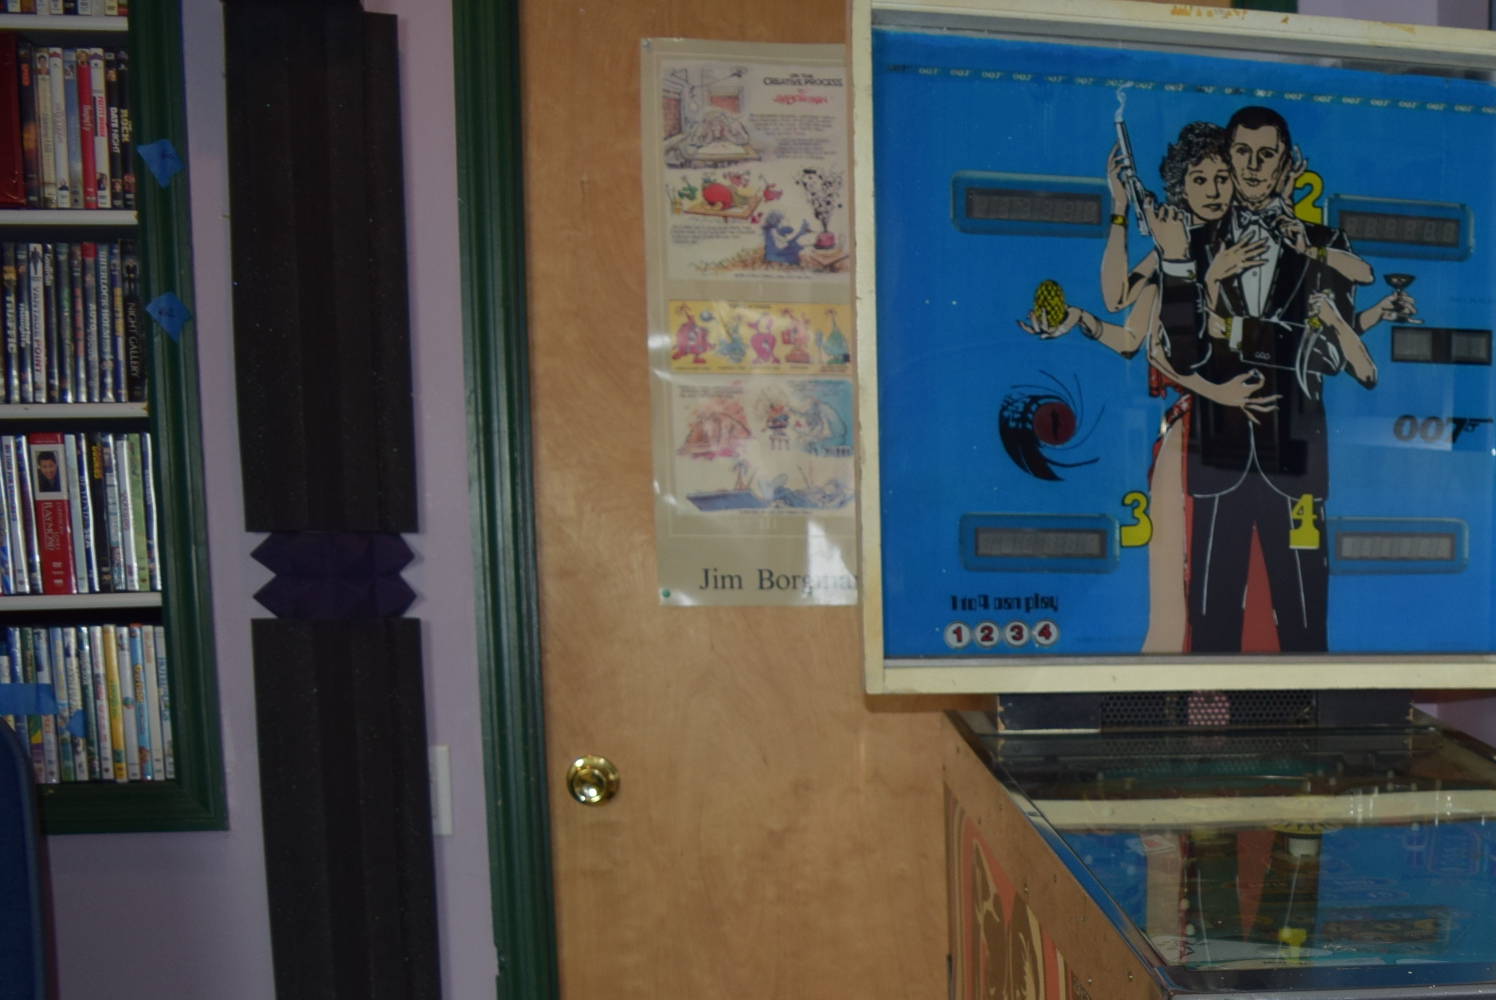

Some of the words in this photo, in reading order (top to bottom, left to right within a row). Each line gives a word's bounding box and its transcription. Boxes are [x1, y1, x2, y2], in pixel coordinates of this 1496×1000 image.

[110, 106, 119, 128] DATE
[112, 129, 120, 154] NIGHT
[1293, 170, 1324, 226] 2
[98, 251, 109, 306] SHERLOCK
[5, 294, 18, 354] TRAFFIC
[33, 286, 43, 338] VANTAGE
[88, 303, 97, 331] AUTO
[127, 302, 138, 334] NIGHT
[34, 339, 43, 374] POINT
[128, 336, 140, 378] GALLERY
[1393, 414, 1494, 443] 007
[43, 502, 54, 551] RAYMOND
[1120, 491, 1154, 548] 3
[1289, 494, 1320, 549] 4
[699, 567, 744, 590] Jim
[961, 596, 977, 611] to
[978, 594, 990, 610] 4
[1025, 593, 1059, 613] play
[952, 626, 963, 643] 1
[980, 625, 994, 642] 2
[1010, 624, 1024, 641] 3
[1038, 623, 1052, 641] 4
